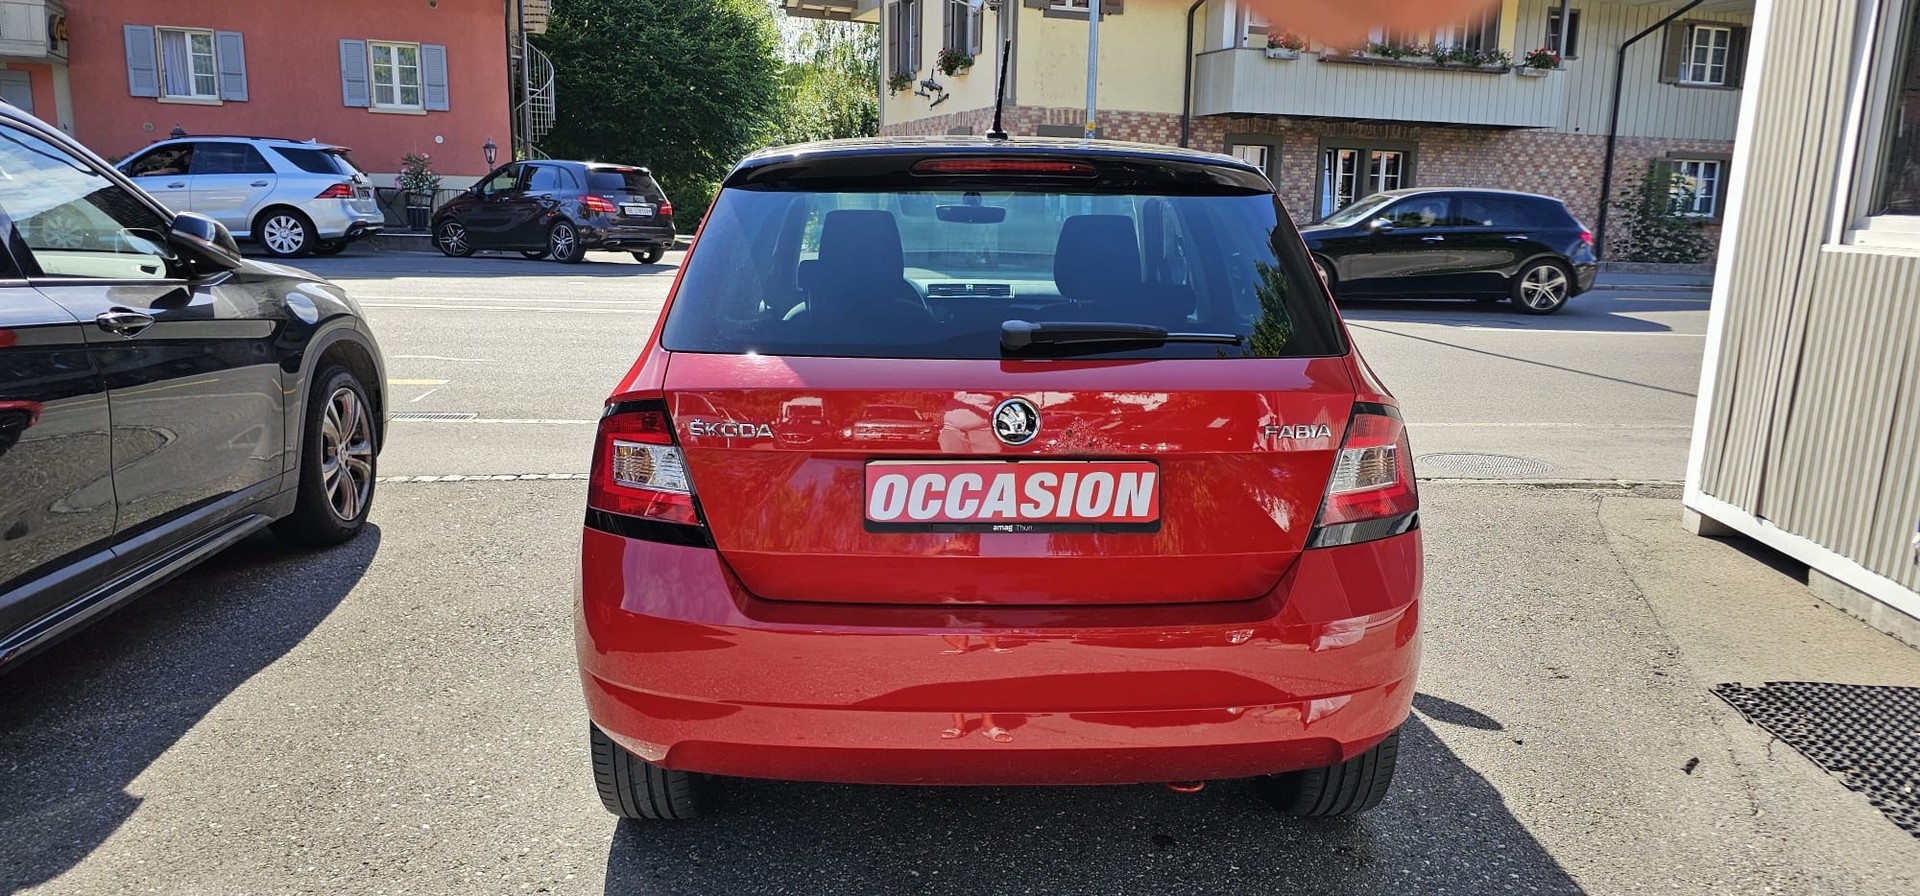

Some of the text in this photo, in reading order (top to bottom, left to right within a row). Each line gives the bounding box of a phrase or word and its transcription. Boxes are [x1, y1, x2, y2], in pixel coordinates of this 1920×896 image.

[690, 418, 774, 438] ŠKODA
[1264, 424, 1331, 440] FABIA
[869, 471, 1156, 520] OCCASION
[993, 524, 1013, 532] amag
